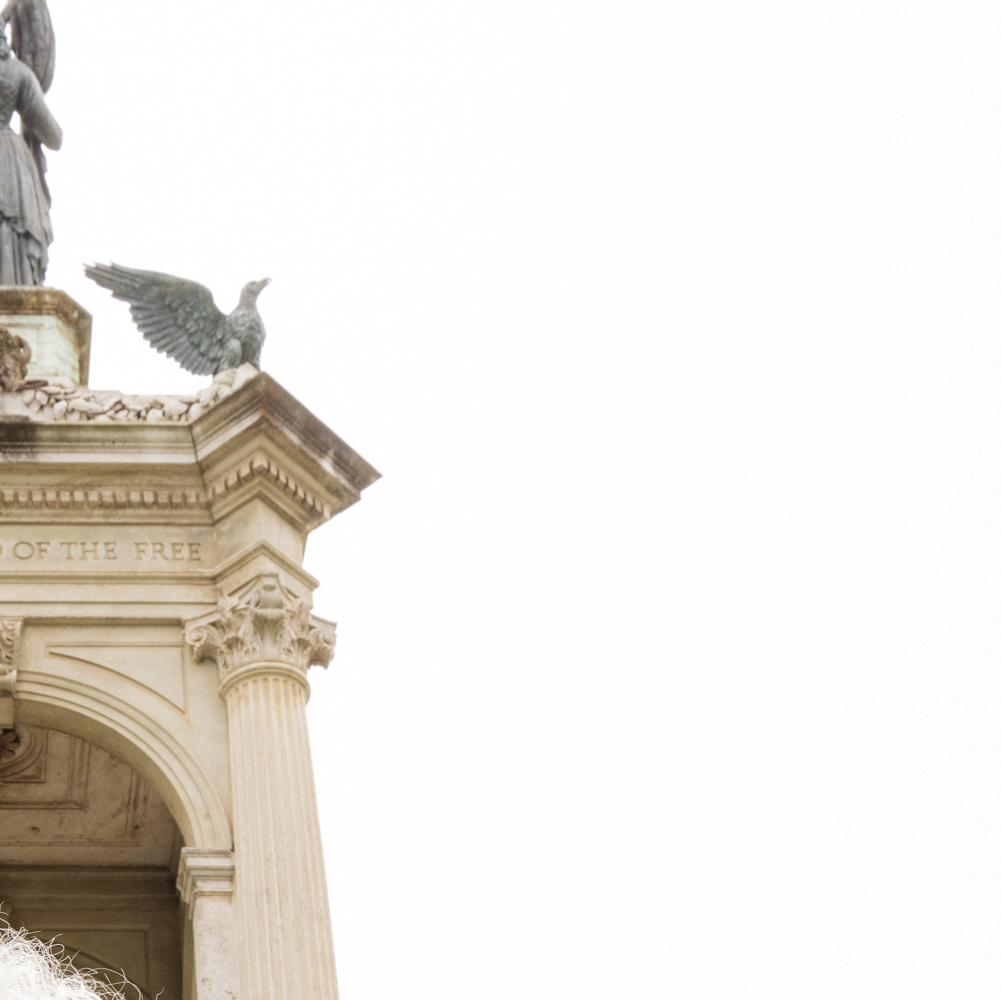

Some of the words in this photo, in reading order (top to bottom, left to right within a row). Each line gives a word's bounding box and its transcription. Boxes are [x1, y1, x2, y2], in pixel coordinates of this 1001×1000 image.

[12, 540, 51, 560] OF
[60, 541, 118, 560] THE
[134, 542, 202, 562] FREE
